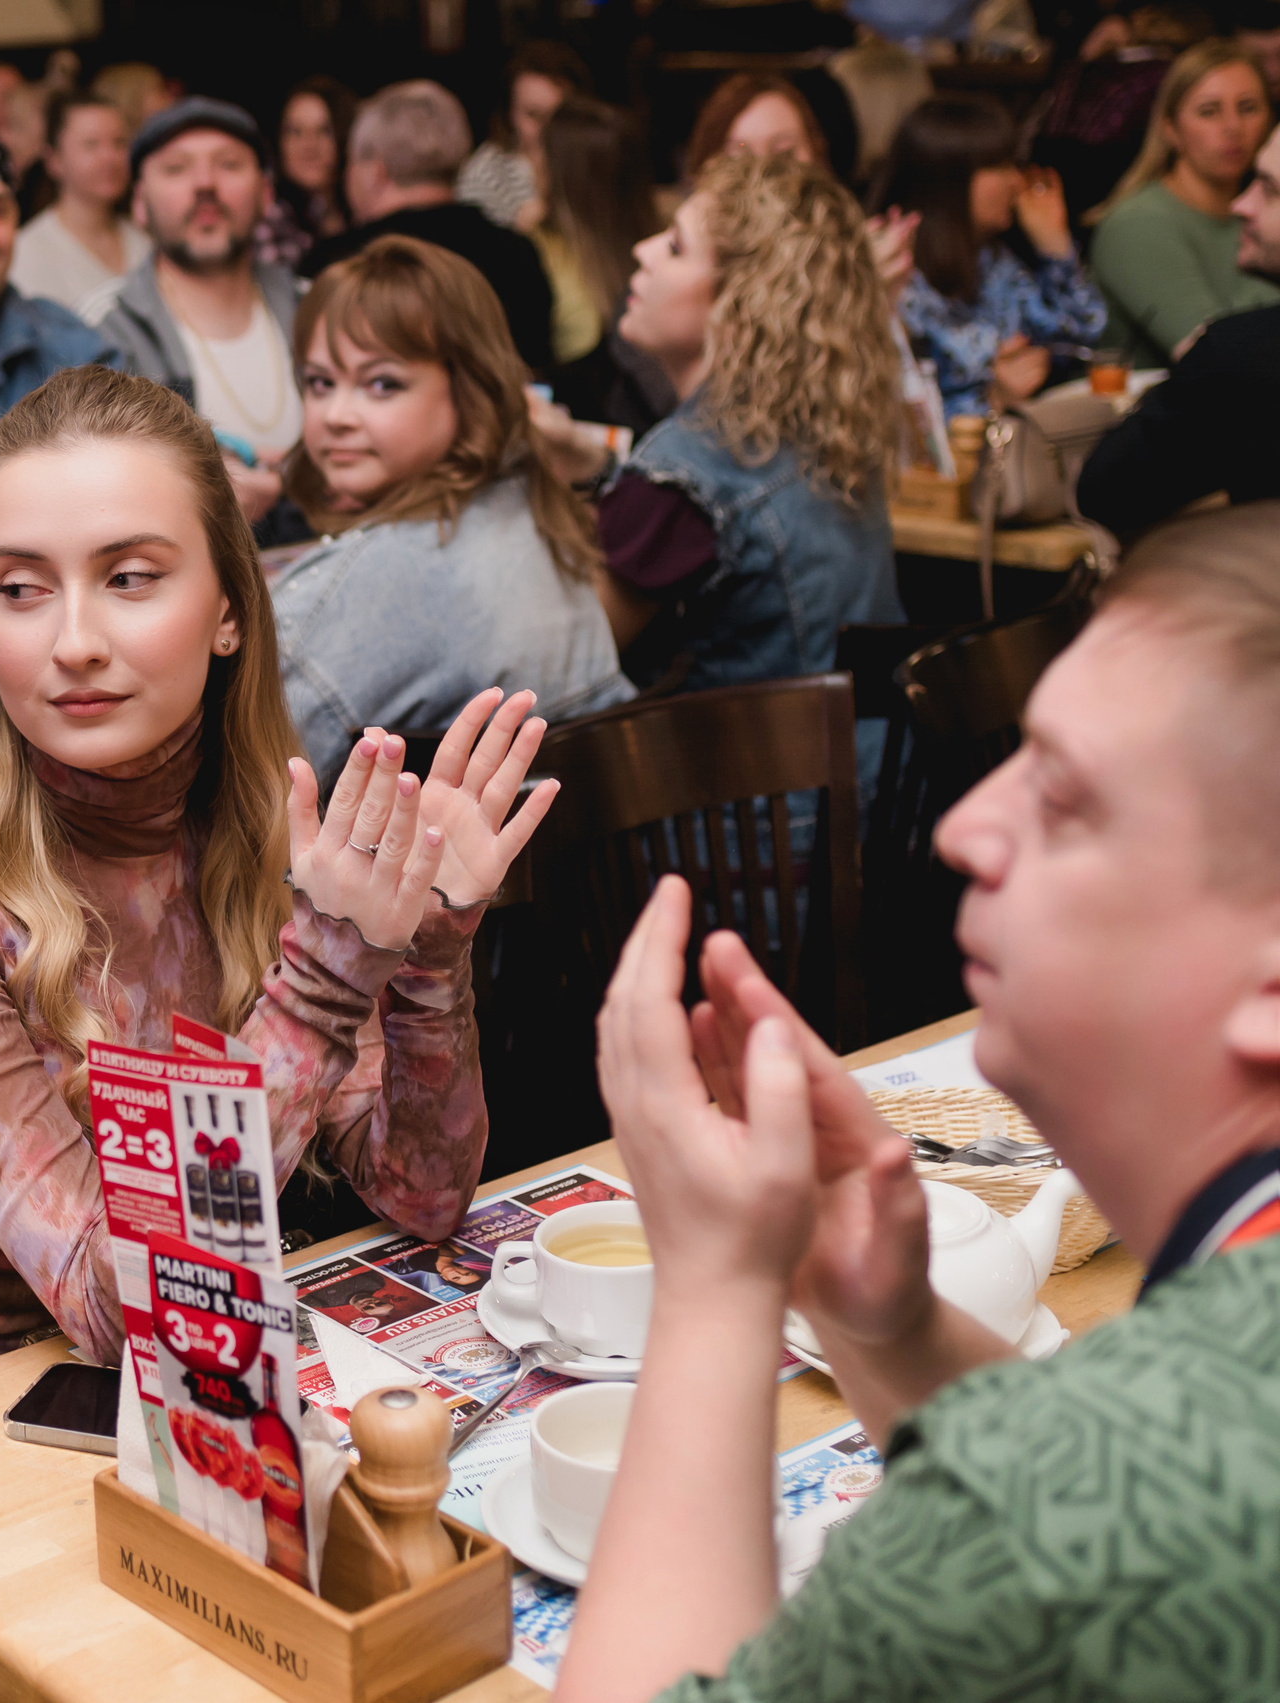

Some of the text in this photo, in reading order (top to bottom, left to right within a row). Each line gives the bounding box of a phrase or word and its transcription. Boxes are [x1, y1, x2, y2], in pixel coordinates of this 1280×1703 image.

[99, 1050, 164, 1077] ПЯТНИЦУ
[166, 1063, 179, 1079] И
[180, 1064, 249, 1086] СУББОТУ
[91, 1079, 169, 1111] УДАЧНЫЙ
[115, 1103, 147, 1124] ЧАС
[154, 1254, 232, 1291] MARTINI
[157, 1279, 292, 1331] FIERO & TONIC
[165, 1309, 191, 1352] 3
[213, 1322, 240, 1369] 2
[193, 1372, 231, 1403] 740
[120, 1545, 309, 1682] MAXIMILIANS.RU
